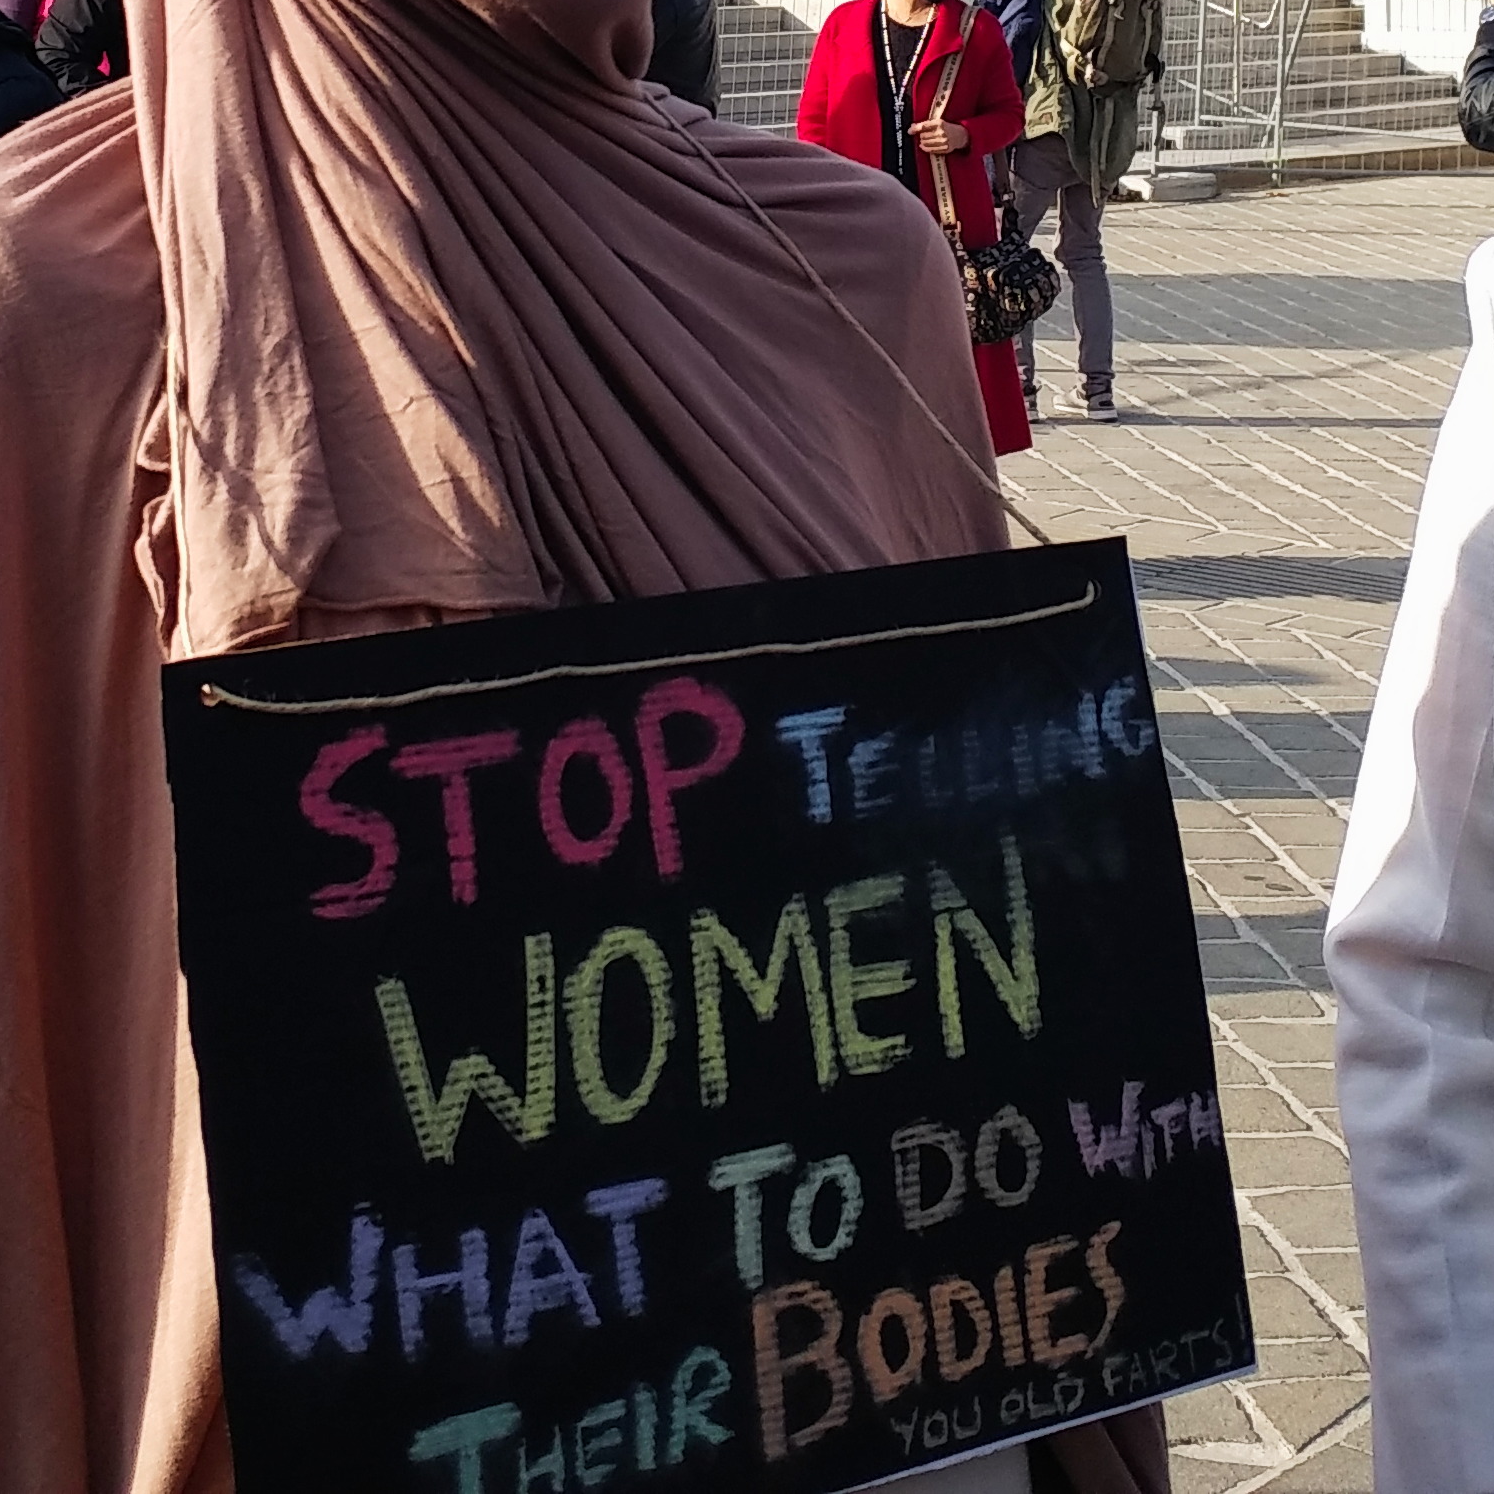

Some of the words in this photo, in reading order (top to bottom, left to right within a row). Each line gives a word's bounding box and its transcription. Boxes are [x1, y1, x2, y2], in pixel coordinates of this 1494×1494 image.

[298, 675, 748, 920] STOP
[775, 674, 1156, 826] TELLING
[374, 833, 1044, 1164] WOMEN
[233, 1175, 671, 1363] WHAT
[707, 1141, 865, 1290] TO
[889, 1103, 1044, 1236] DO
[1068, 1077, 1223, 1181] WITH
[407, 1343, 736, 1494] THEIR
[753, 1219, 1126, 1465] BODIES
[889, 1396, 983, 1456] YOU
[1000, 1371, 1086, 1425] OLD
[1101, 1291, 1251, 1398] FARTS!
